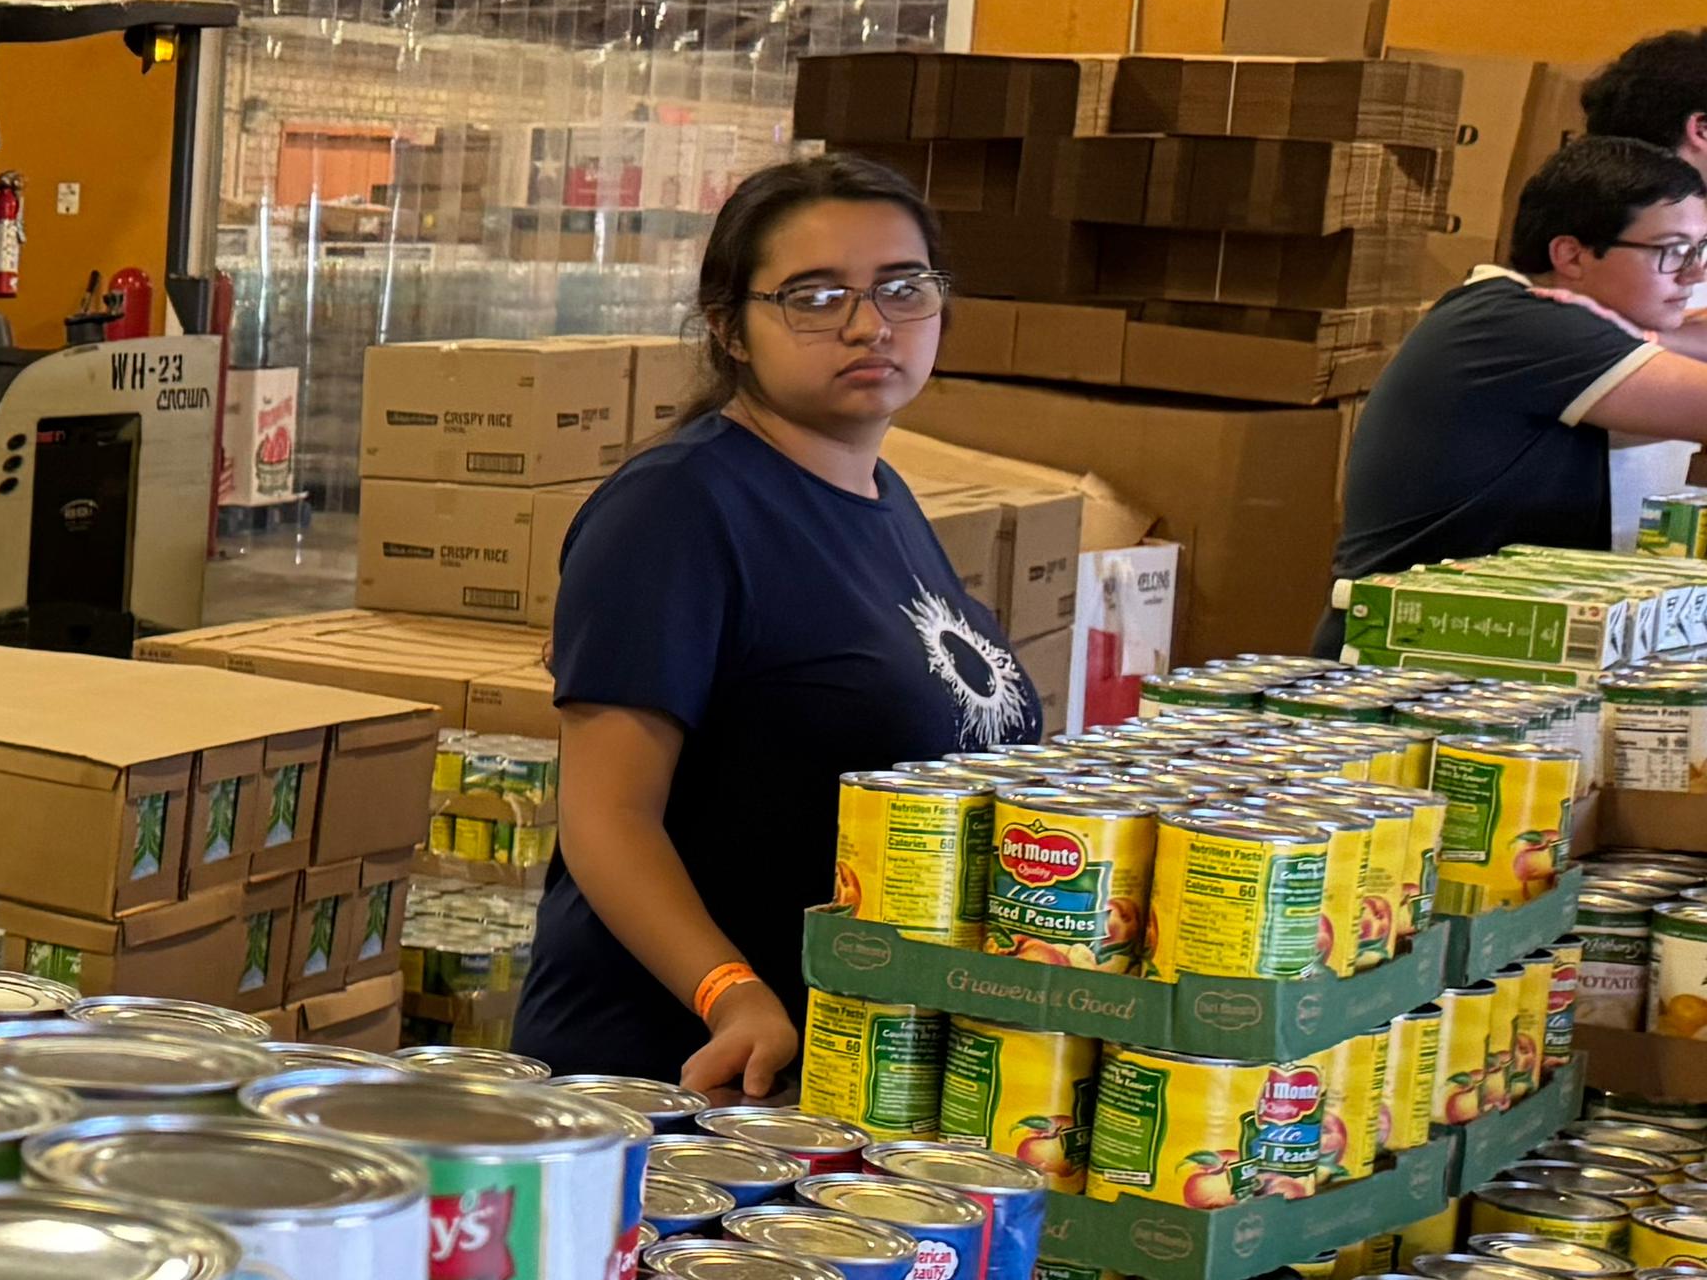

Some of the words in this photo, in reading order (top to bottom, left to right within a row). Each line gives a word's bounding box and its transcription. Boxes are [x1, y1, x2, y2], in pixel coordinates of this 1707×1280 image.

[111, 352, 184, 391] WH-23
[156, 387, 211, 411] CROWN
[443, 410, 485, 428] CRISPY
[487, 412, 513, 429] RICE
[440, 544, 480, 561] CRISPY
[483, 547, 509, 564] RICE
[890, 802, 932, 816] Nutrition
[939, 838, 955, 850] 60
[1003, 837, 1024, 860] Del
[1024, 842, 1080, 867] Monte
[1189, 842, 1236, 859] Nutrition
[1237, 848, 1263, 862] Facts
[1017, 863, 1053, 882] Quality
[1184, 880, 1225, 897] Calories
[1238, 883, 1257, 897] 60
[1024, 908, 1096, 934] Peaches
[946, 968, 1045, 1005] Growers
[1068, 986, 1139, 1021] Good
[844, 1039, 861, 1054] 60
[1277, 1079, 1319, 1102] Monte
